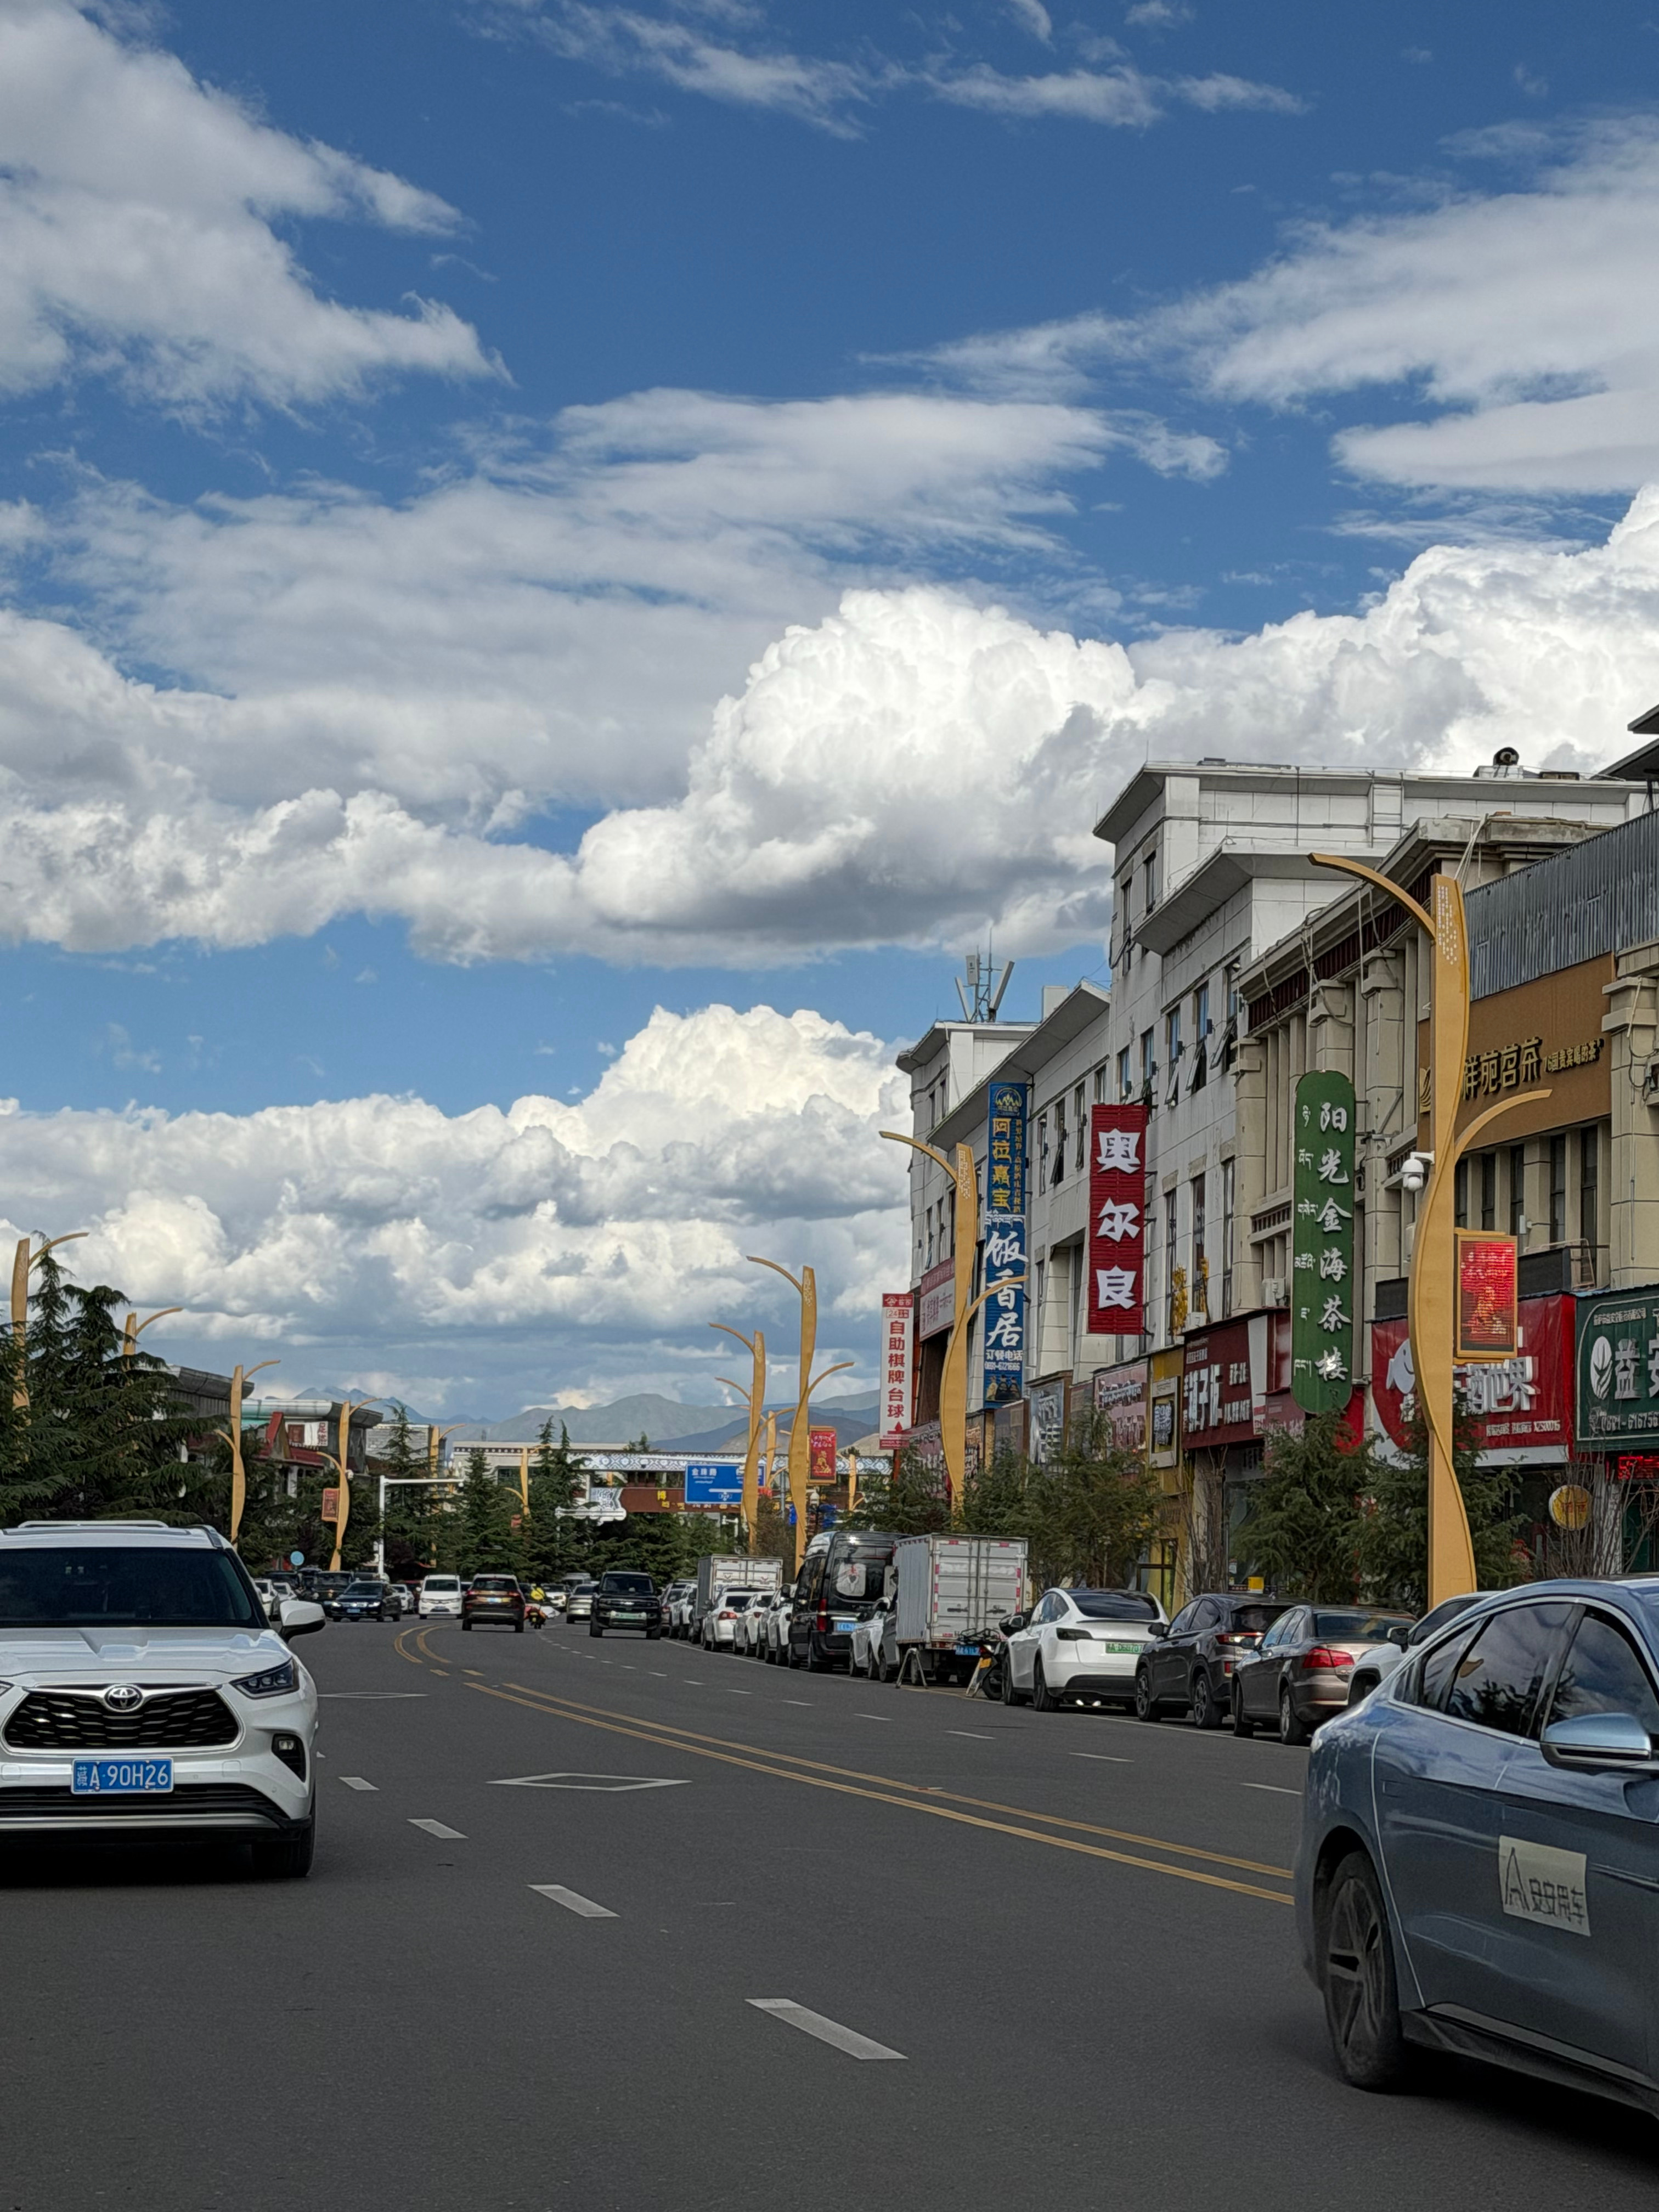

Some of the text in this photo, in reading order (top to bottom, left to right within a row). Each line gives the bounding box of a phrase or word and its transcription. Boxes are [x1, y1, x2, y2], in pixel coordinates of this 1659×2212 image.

[1097, 1128, 1141, 1310] 奥尔良
[1316, 1102, 1352, 1381] 阳光金海茶楼
[985, 1231, 1029, 1347] 饭香居
[887, 1320, 905, 1418] 自助棋牌台球
[1453, 1356, 1541, 1417] 酒世界
